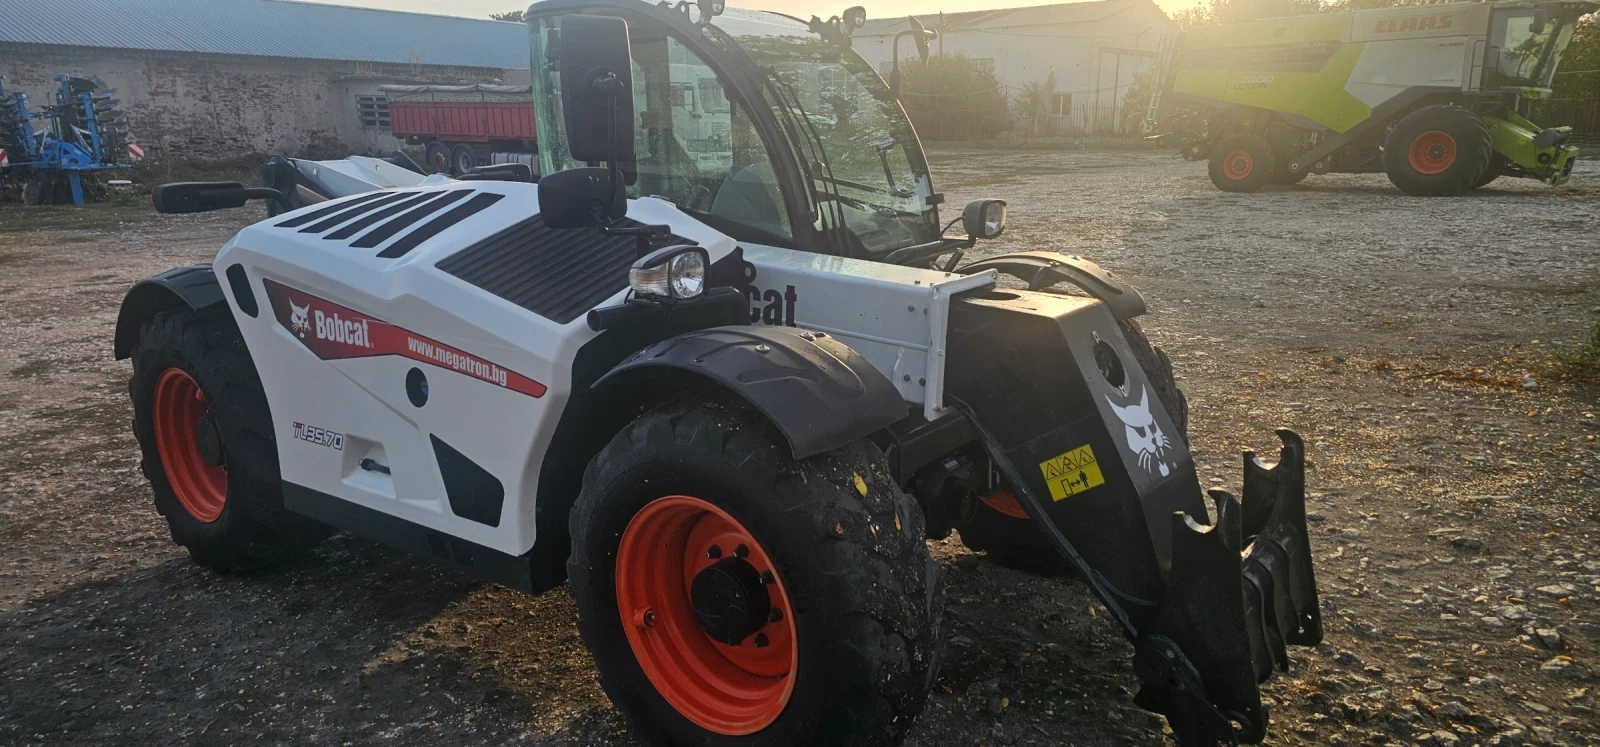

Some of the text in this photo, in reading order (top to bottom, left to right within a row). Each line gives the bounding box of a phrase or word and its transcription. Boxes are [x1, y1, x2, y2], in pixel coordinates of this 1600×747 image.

[1375, 13, 1454, 34] CLAAS
[314, 310, 371, 348] Bobcat
[407, 336, 507, 387] www.megatron.bg
[293, 421, 344, 451] TL35.70
